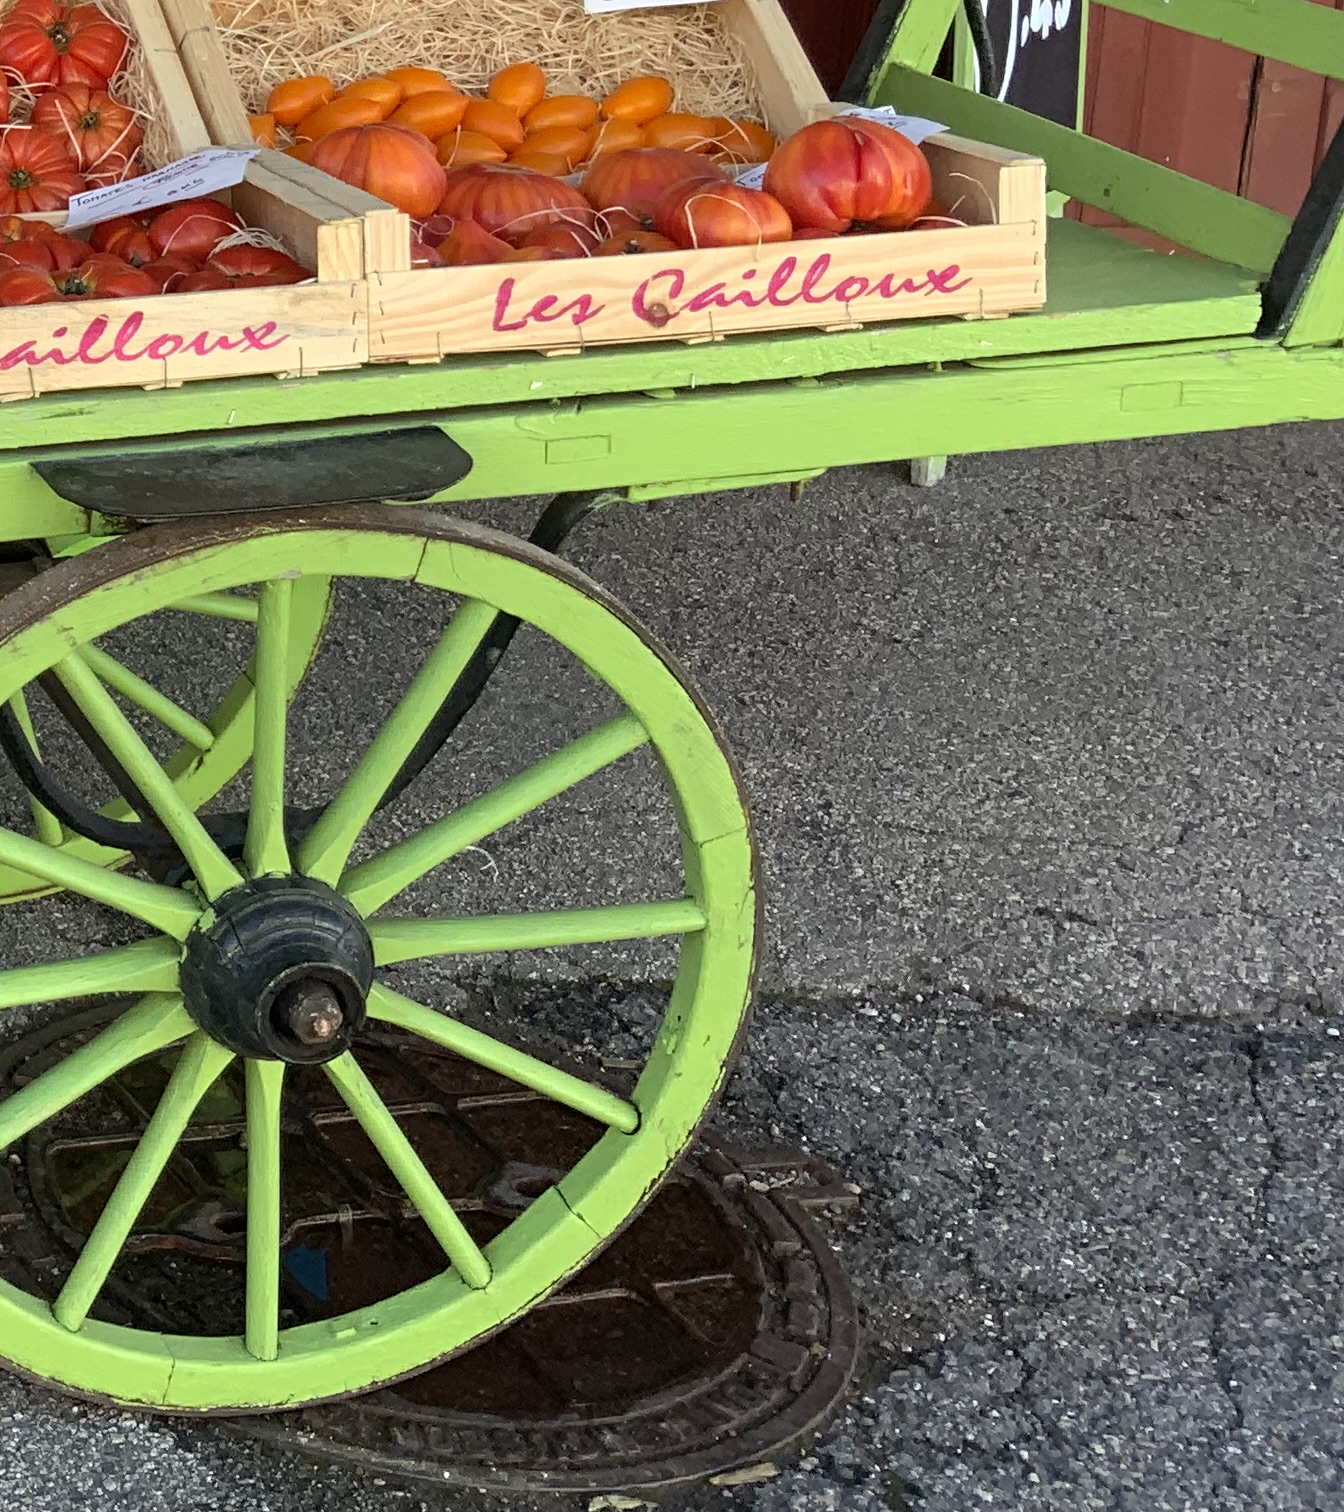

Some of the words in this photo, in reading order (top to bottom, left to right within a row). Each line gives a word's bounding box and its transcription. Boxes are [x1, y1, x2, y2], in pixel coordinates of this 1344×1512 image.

[71, 184, 134, 207] TOMATES
[492, 275, 606, 335] Les
[629, 253, 974, 331] Cailloux
